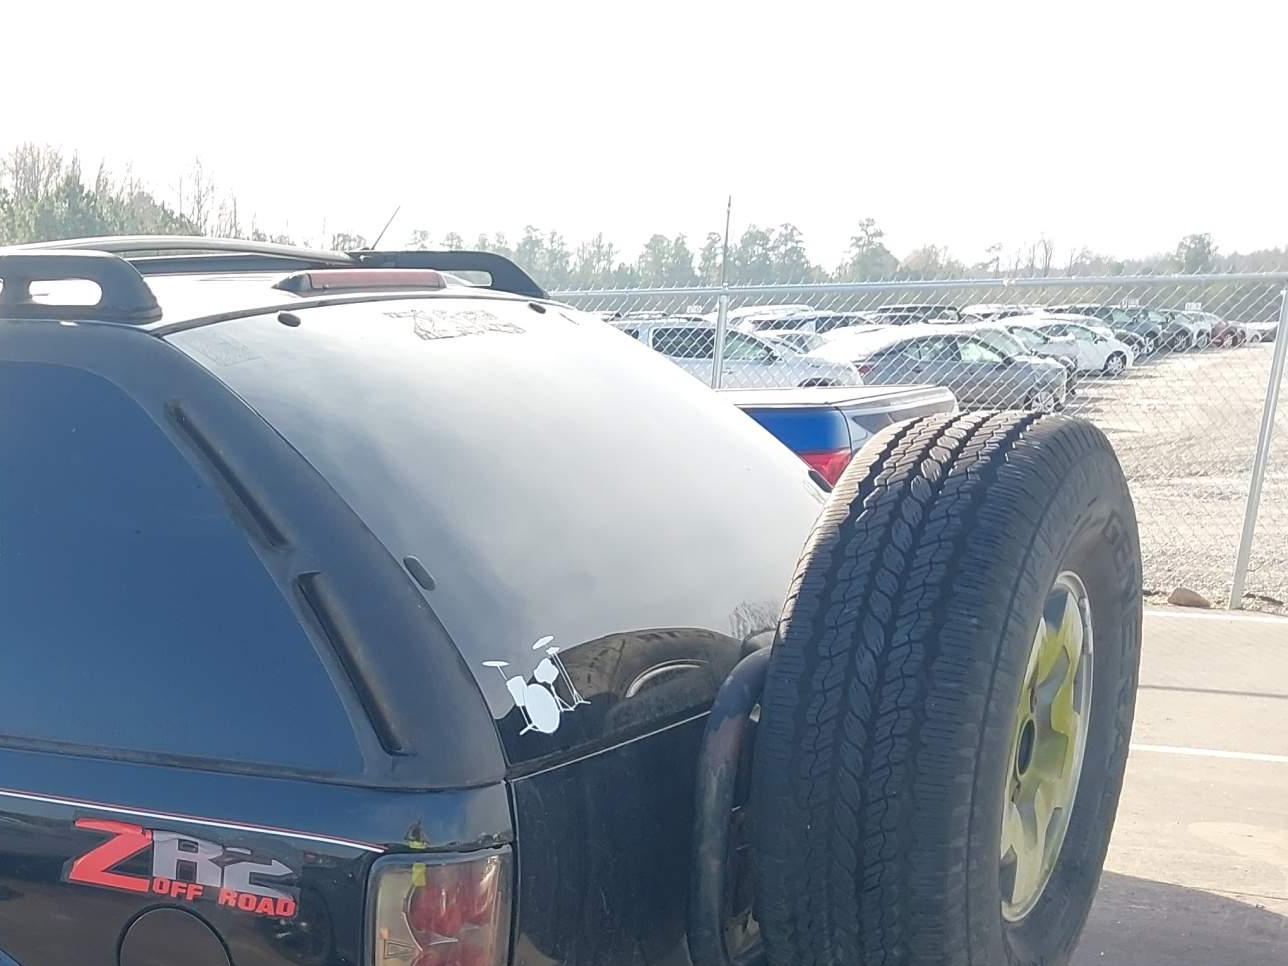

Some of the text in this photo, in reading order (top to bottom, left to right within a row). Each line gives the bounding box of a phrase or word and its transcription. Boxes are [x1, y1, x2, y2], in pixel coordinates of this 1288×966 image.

[69, 817, 296, 899] ZR2
[152, 877, 297, 917] OFF ROAD
